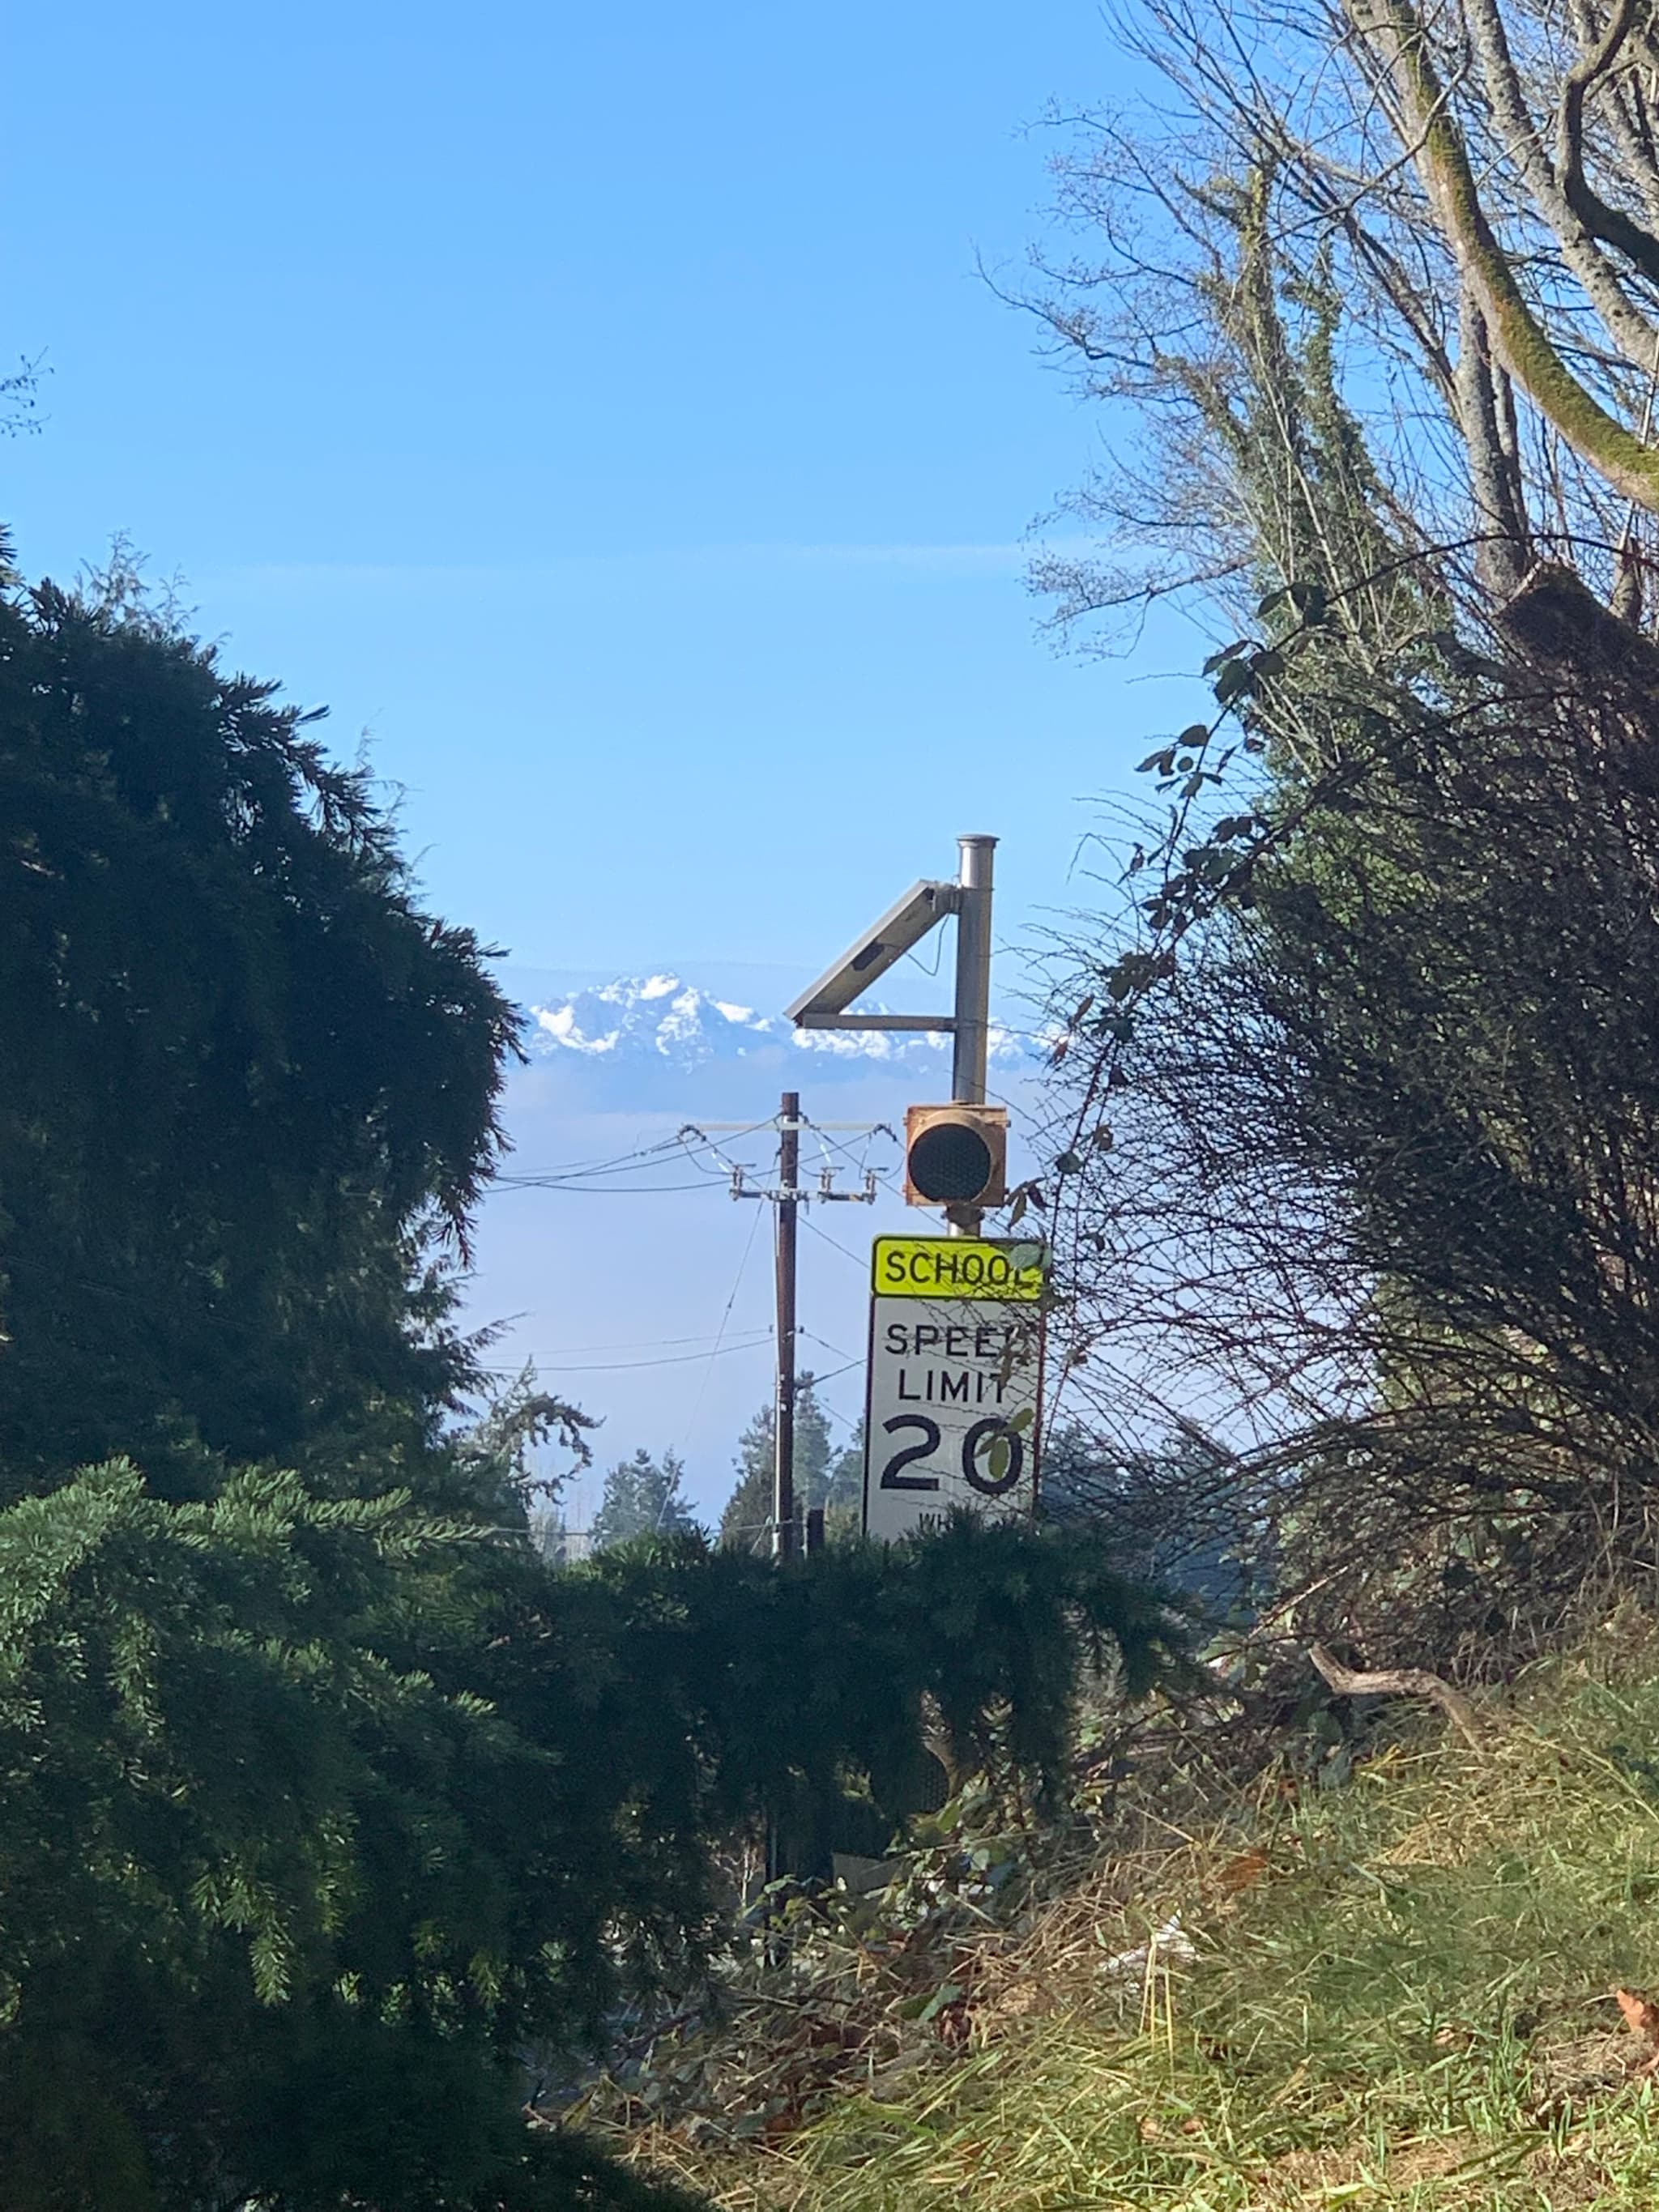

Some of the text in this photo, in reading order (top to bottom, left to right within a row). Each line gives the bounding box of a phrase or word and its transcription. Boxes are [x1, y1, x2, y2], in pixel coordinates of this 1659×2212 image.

[885, 1323, 1027, 1358] SPEE
[898, 1368, 1009, 1404] LIMIT
[880, 1413, 1023, 1495] 20
